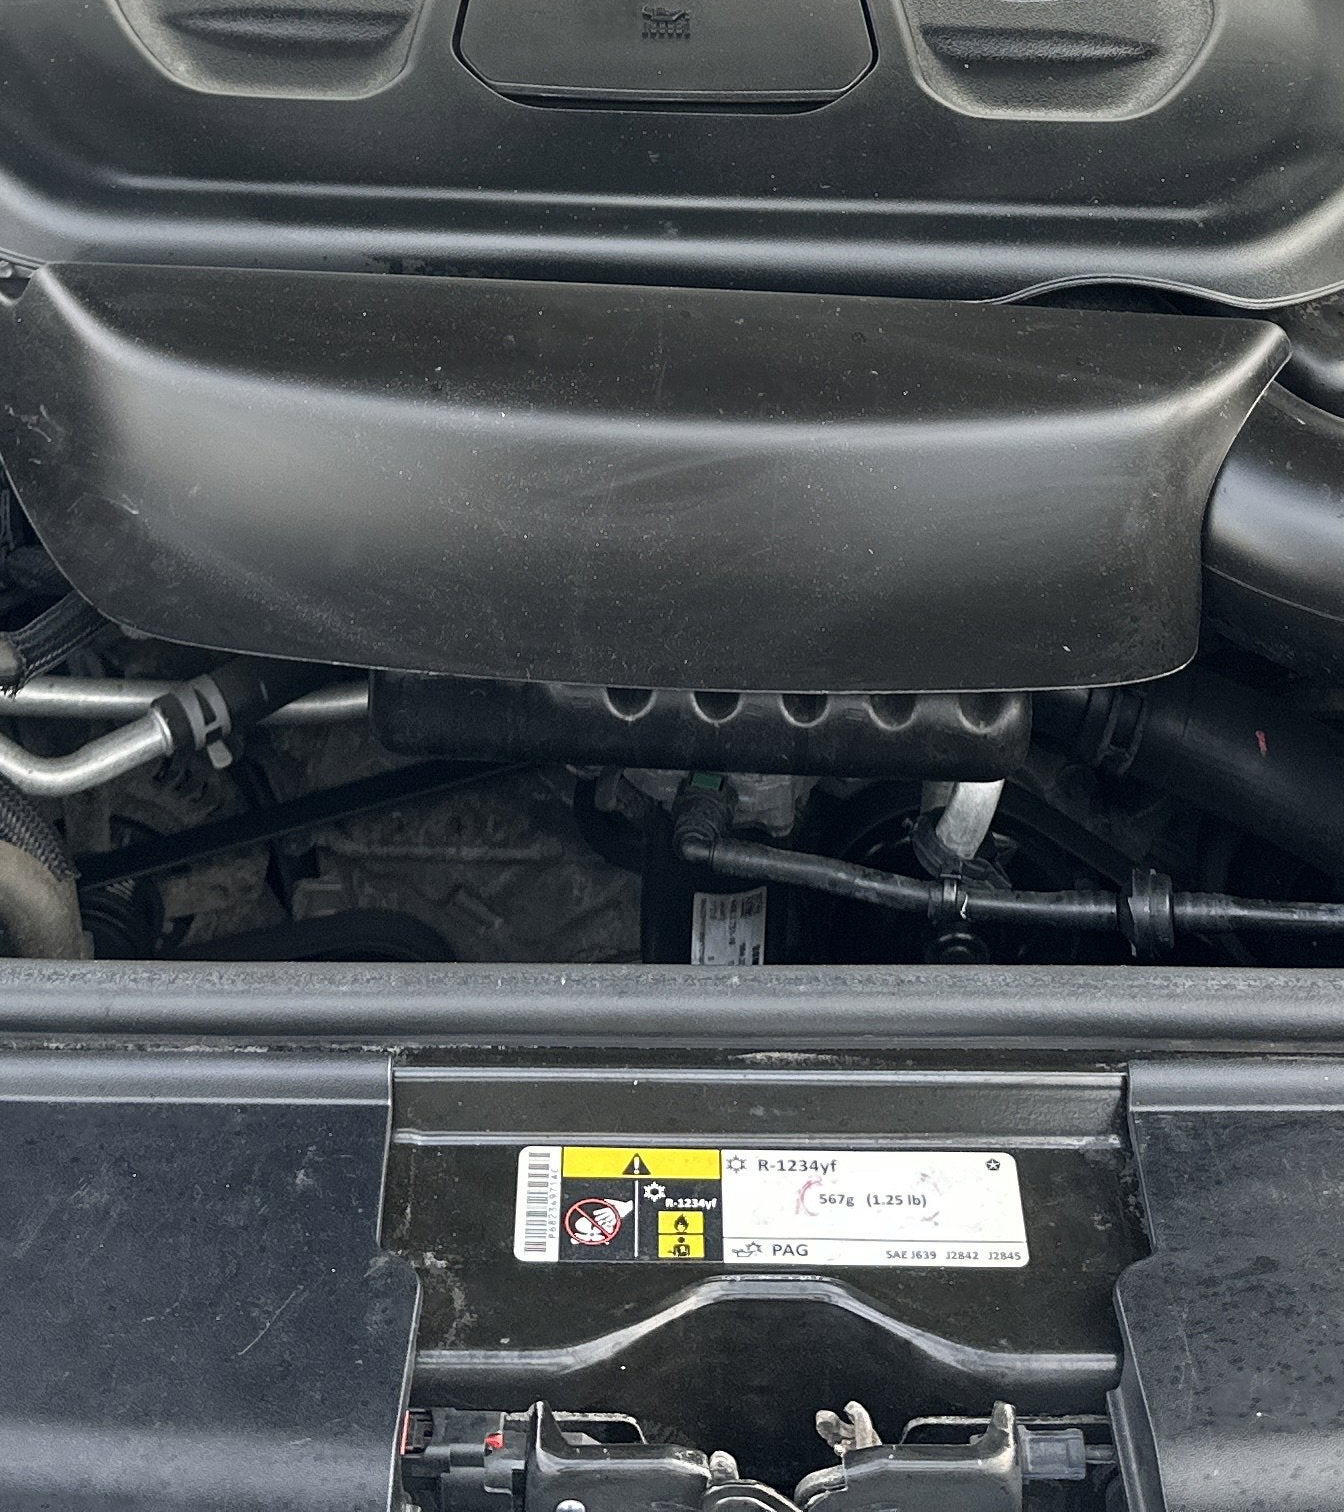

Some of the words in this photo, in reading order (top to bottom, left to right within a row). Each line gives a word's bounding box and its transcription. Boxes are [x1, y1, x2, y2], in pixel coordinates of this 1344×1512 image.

[758, 1159, 837, 1175] R-1234yf
[665, 1197, 718, 1211] R-1234yf
[819, 1193, 855, 1207] 567g
[866, 1192, 904, 1208] (1.25
[907, 1192, 928, 1208] lb)
[772, 1243, 809, 1257] PAG
[885, 1249, 908, 1260] SAE
[910, 1249, 937, 1260] J639
[945, 1250, 980, 1261] J2842
[987, 1251, 1022, 1261] J2845
